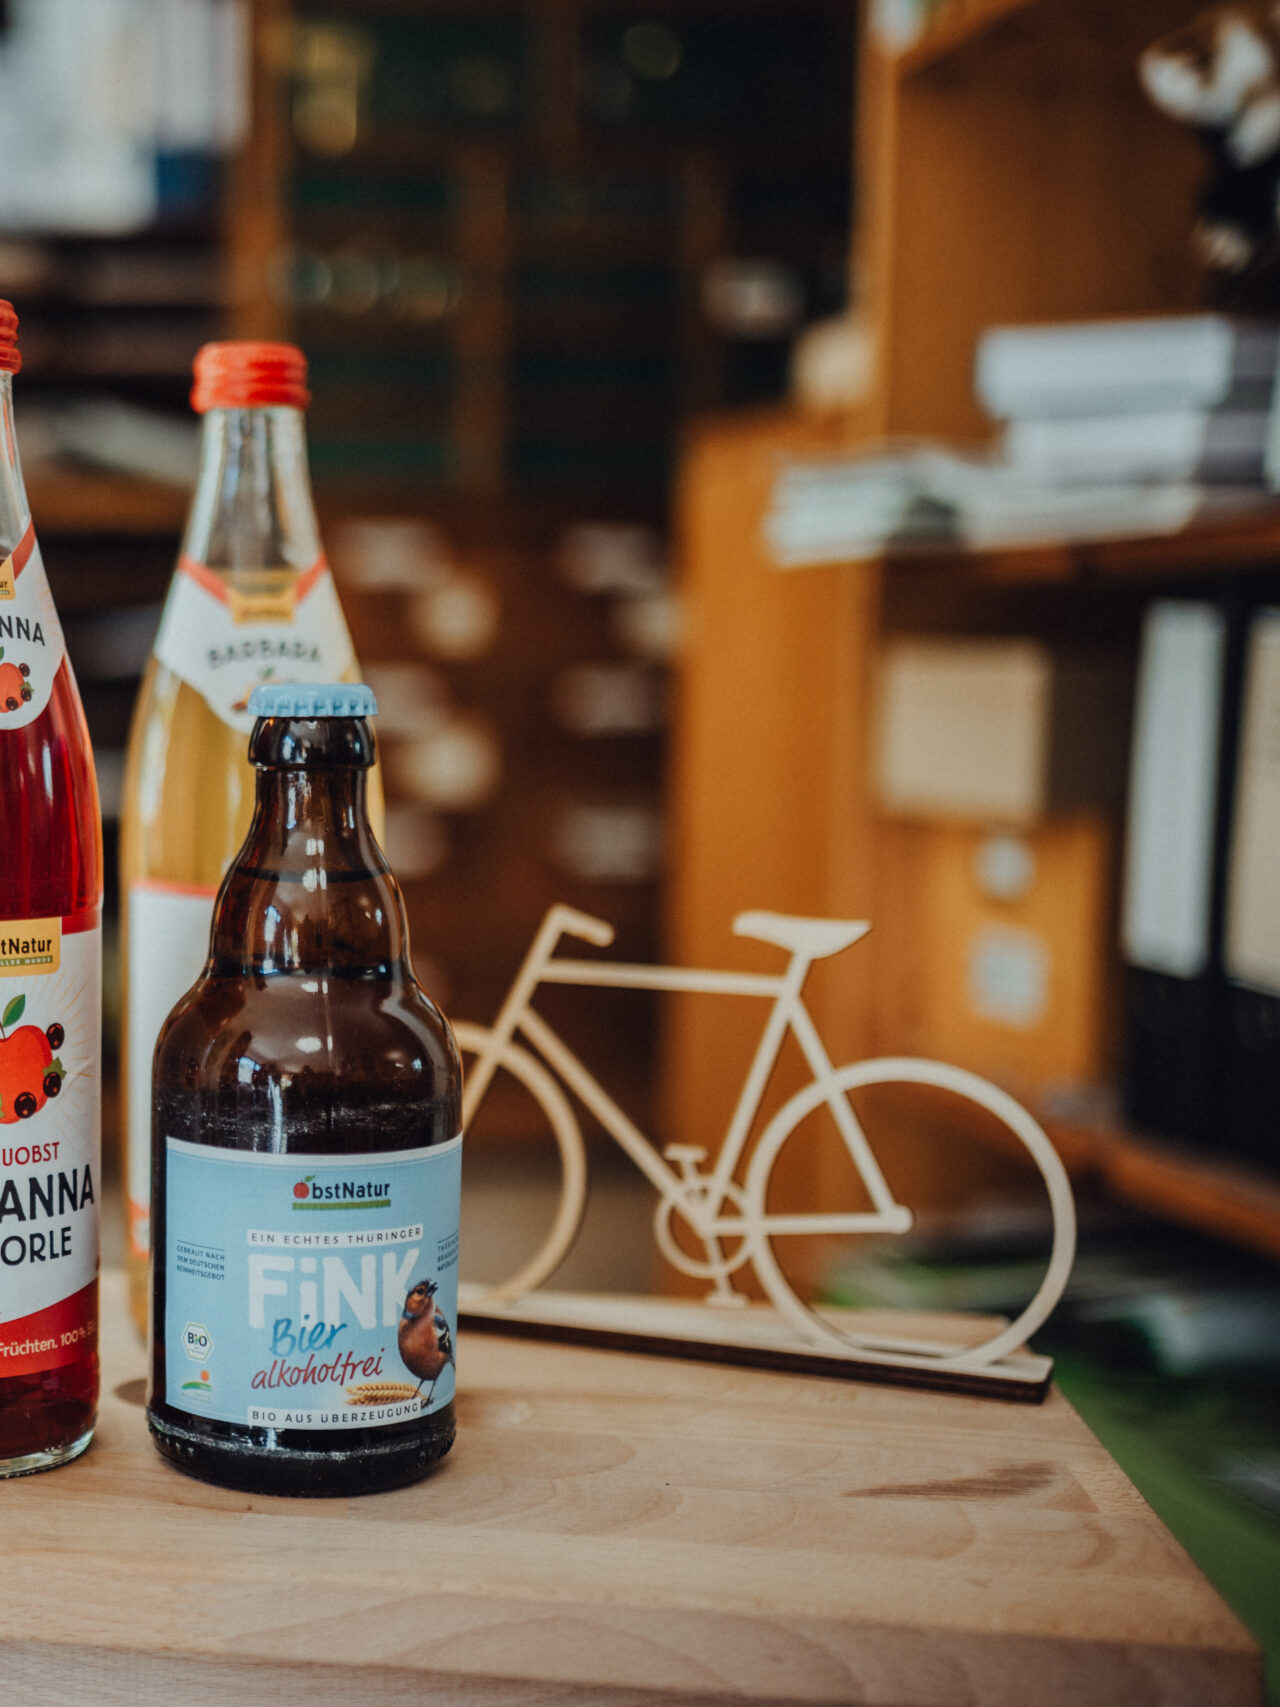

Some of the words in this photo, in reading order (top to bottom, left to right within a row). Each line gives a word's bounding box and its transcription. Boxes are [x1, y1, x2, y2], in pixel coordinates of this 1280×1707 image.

[251, 1232, 275, 1243] EIN
[283, 1235, 339, 1245] ECHTES
[205, 1252, 225, 1261] NACH
[268, 1313, 348, 1358] Bier
[250, 1347, 386, 1391] alkoholfrei
[252, 1410, 277, 1421] BIO
[285, 1413, 312, 1423] AUS
